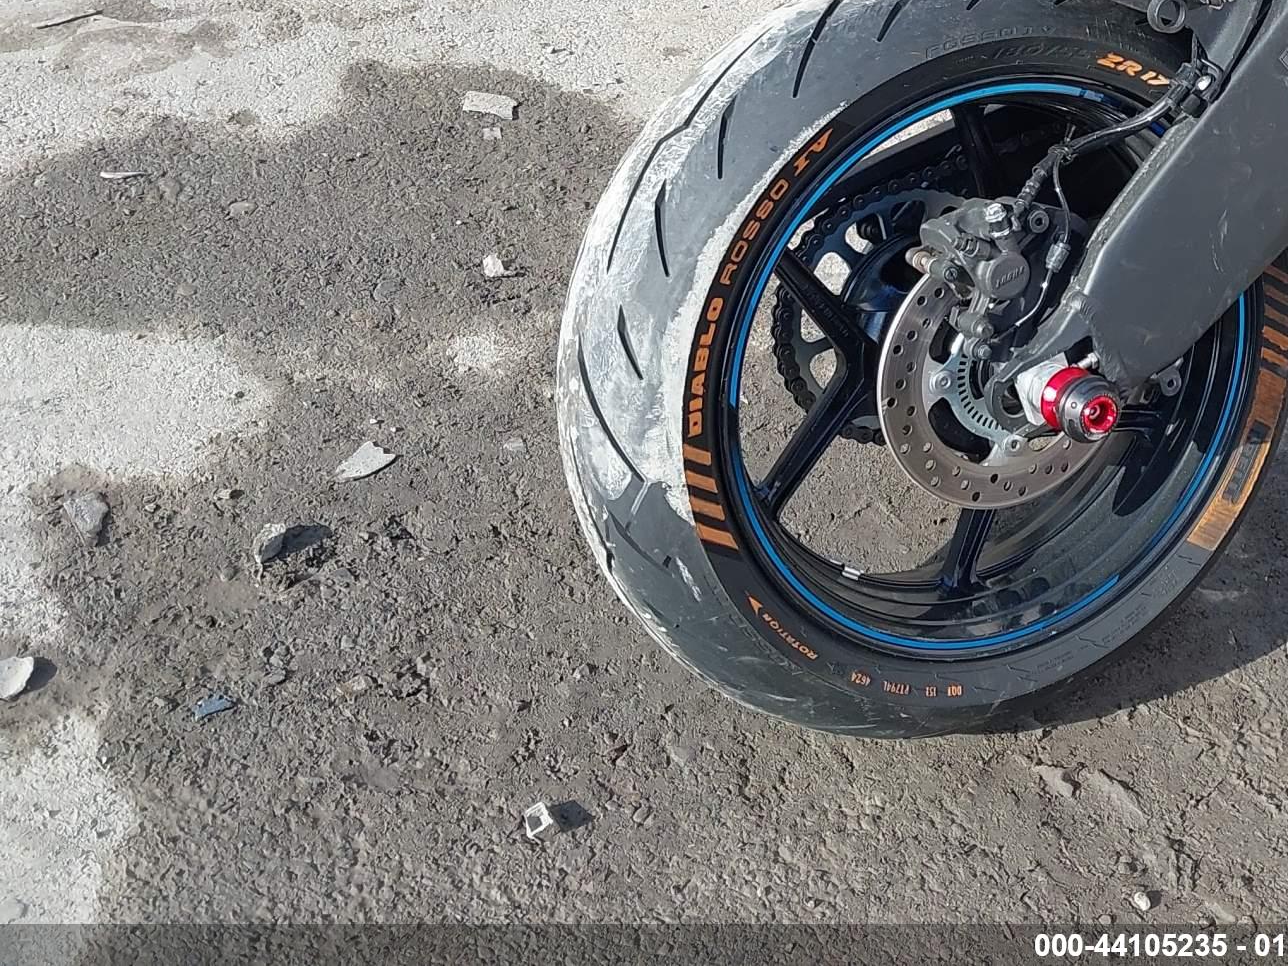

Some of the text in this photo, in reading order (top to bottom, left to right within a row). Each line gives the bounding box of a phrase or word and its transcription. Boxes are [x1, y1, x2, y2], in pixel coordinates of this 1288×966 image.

[1096, 52, 1142, 76] ZR
[1140, 70, 1170, 86] 17
[688, 296, 724, 438] DIABLO
[720, 178, 789, 286] ROSSO
[762, 612, 818, 660] ROTATION
[947, 685, 962, 697] DOT
